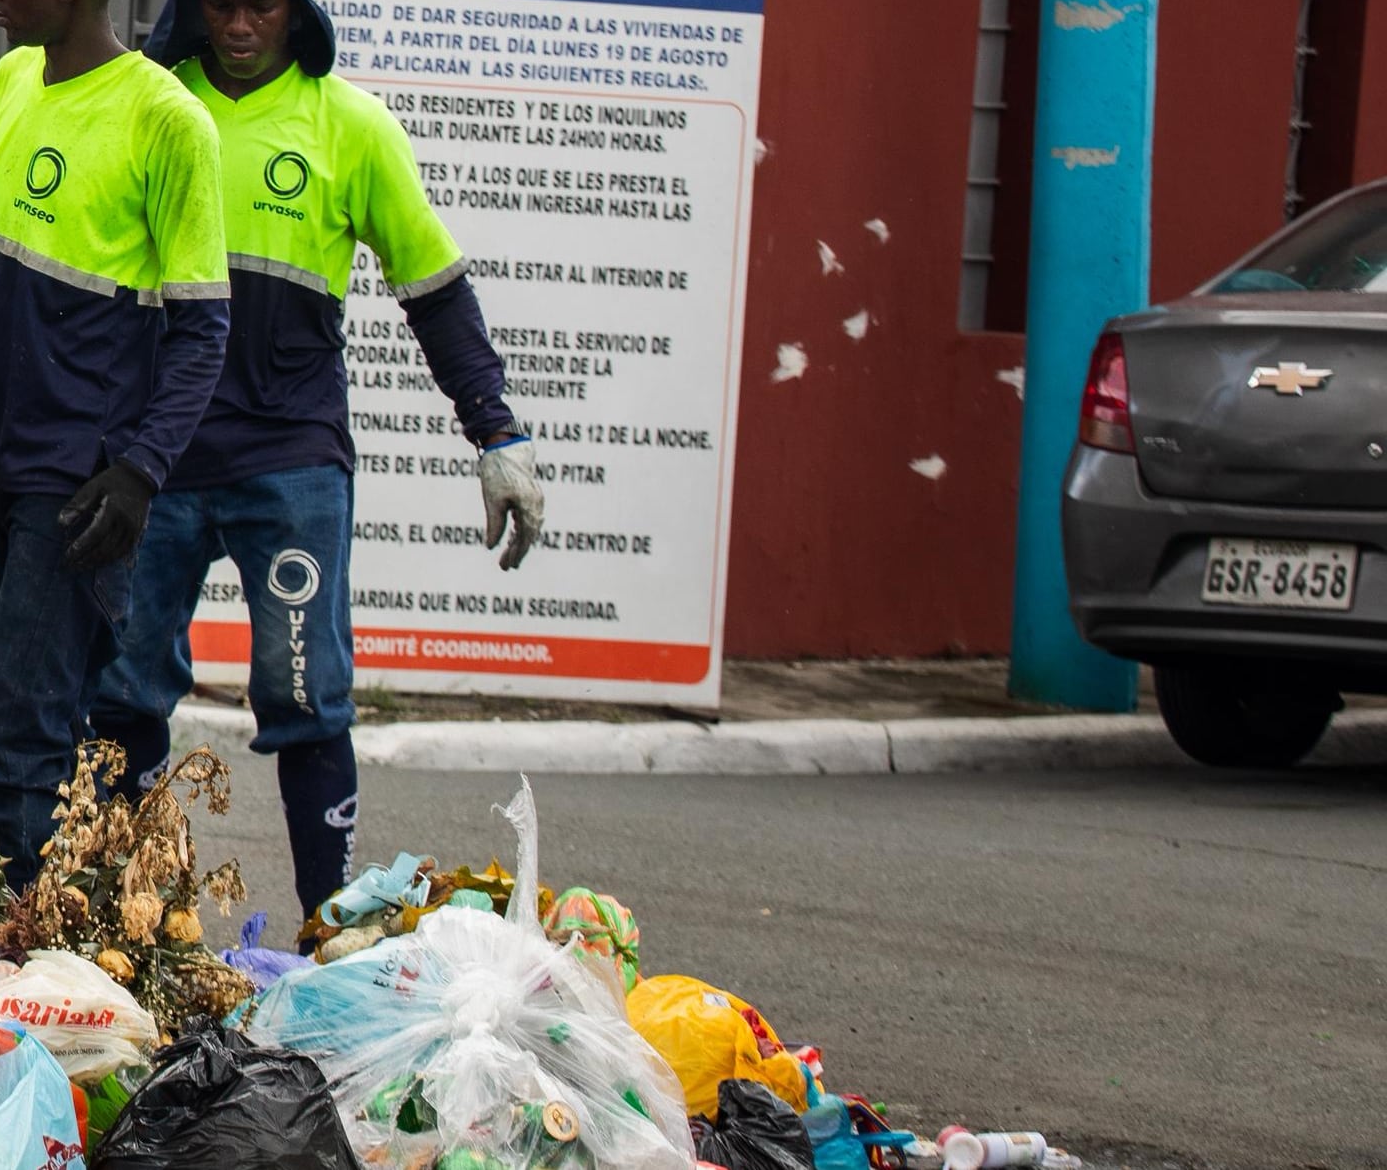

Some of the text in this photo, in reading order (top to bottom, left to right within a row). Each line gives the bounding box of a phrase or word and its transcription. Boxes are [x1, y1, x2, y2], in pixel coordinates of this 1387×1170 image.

[315, 1, 743, 44] ALIDAD DE DAR SEGURIDAD A LAS VIVIENDAS DE
[383, 32, 395, 45] A
[401, 31, 463, 50] PARTIR
[469, 35, 500, 53] DEL
[507, 34, 535, 55] DÍA
[543, 41, 598, 59] LUNES
[607, 45, 624, 60] 19
[631, 46, 652, 62] DE
[658, 48, 729, 68] AGOSTO
[338, 53, 360, 69] SE
[371, 55, 471, 76] APLICARÁN
[482, 62, 514, 79] LAS
[521, 63, 625, 86] SIGUIENTES
[386, 93, 415, 112] LOS
[420, 96, 515, 119] RESIDENTES
[524, 101, 535, 120] Y
[540, 102, 560, 121] DE
[564, 104, 593, 123] LOS
[598, 106, 687, 129] INQUILINOS
[449, 122, 520, 144] DURANTE
[526, 127, 554, 146] LAS
[559, 129, 606, 149] 24H00
[610, 132, 666, 153] HORAS.
[417, 163, 690, 197] TES Y A LOS QUE SE LES PRESTA EL
[253, 200, 305, 221] urvaseo
[527, 194, 604, 217] INGRESAR
[609, 198, 658, 220] HASTA
[663, 203, 691, 221] LAS
[468, 256, 688, 290] ODRÁ ESTAR AL INTERIOR DE
[347, 320, 356, 338] A
[362, 321, 391, 340] LOS
[490, 328, 547, 349] PRESTA
[553, 331, 570, 350] EL
[576, 332, 647, 354] SERVICIO
[652, 336, 671, 355] DE
[347, 344, 410, 367] PODRÁN
[501, 354, 565, 374] NTERIOR
[570, 356, 589, 375] DE
[594, 358, 613, 376] LA
[364, 371, 392, 389] LAS
[505, 378, 587, 399] SIGUIENTE
[352, 412, 422, 435] TONALES
[427, 416, 446, 436] SE
[538, 422, 548, 441] A
[553, 423, 582, 442] LAS
[588, 425, 604, 443] 12
[609, 426, 627, 444] DE
[632, 427, 651, 446] LA
[656, 428, 713, 450] NOCHE.
[355, 454, 389, 473] ITES
[395, 456, 414, 475] DE
[534, 464, 556, 481] NO
[561, 464, 605, 484] PITAR
[353, 522, 403, 547] ACIOS,
[408, 525, 427, 543] EL
[566, 532, 627, 553] DENTRO
[632, 536, 651, 555] DE
[1208, 558, 1347, 600] GSR-8458
[419, 593, 450, 612] QUE
[456, 594, 487, 614] NOS
[492, 596, 523, 617] DAN
[528, 598, 620, 621] SEGURIDAD.
[353, 633, 553, 663] COMITÉ COORDINADOR.
